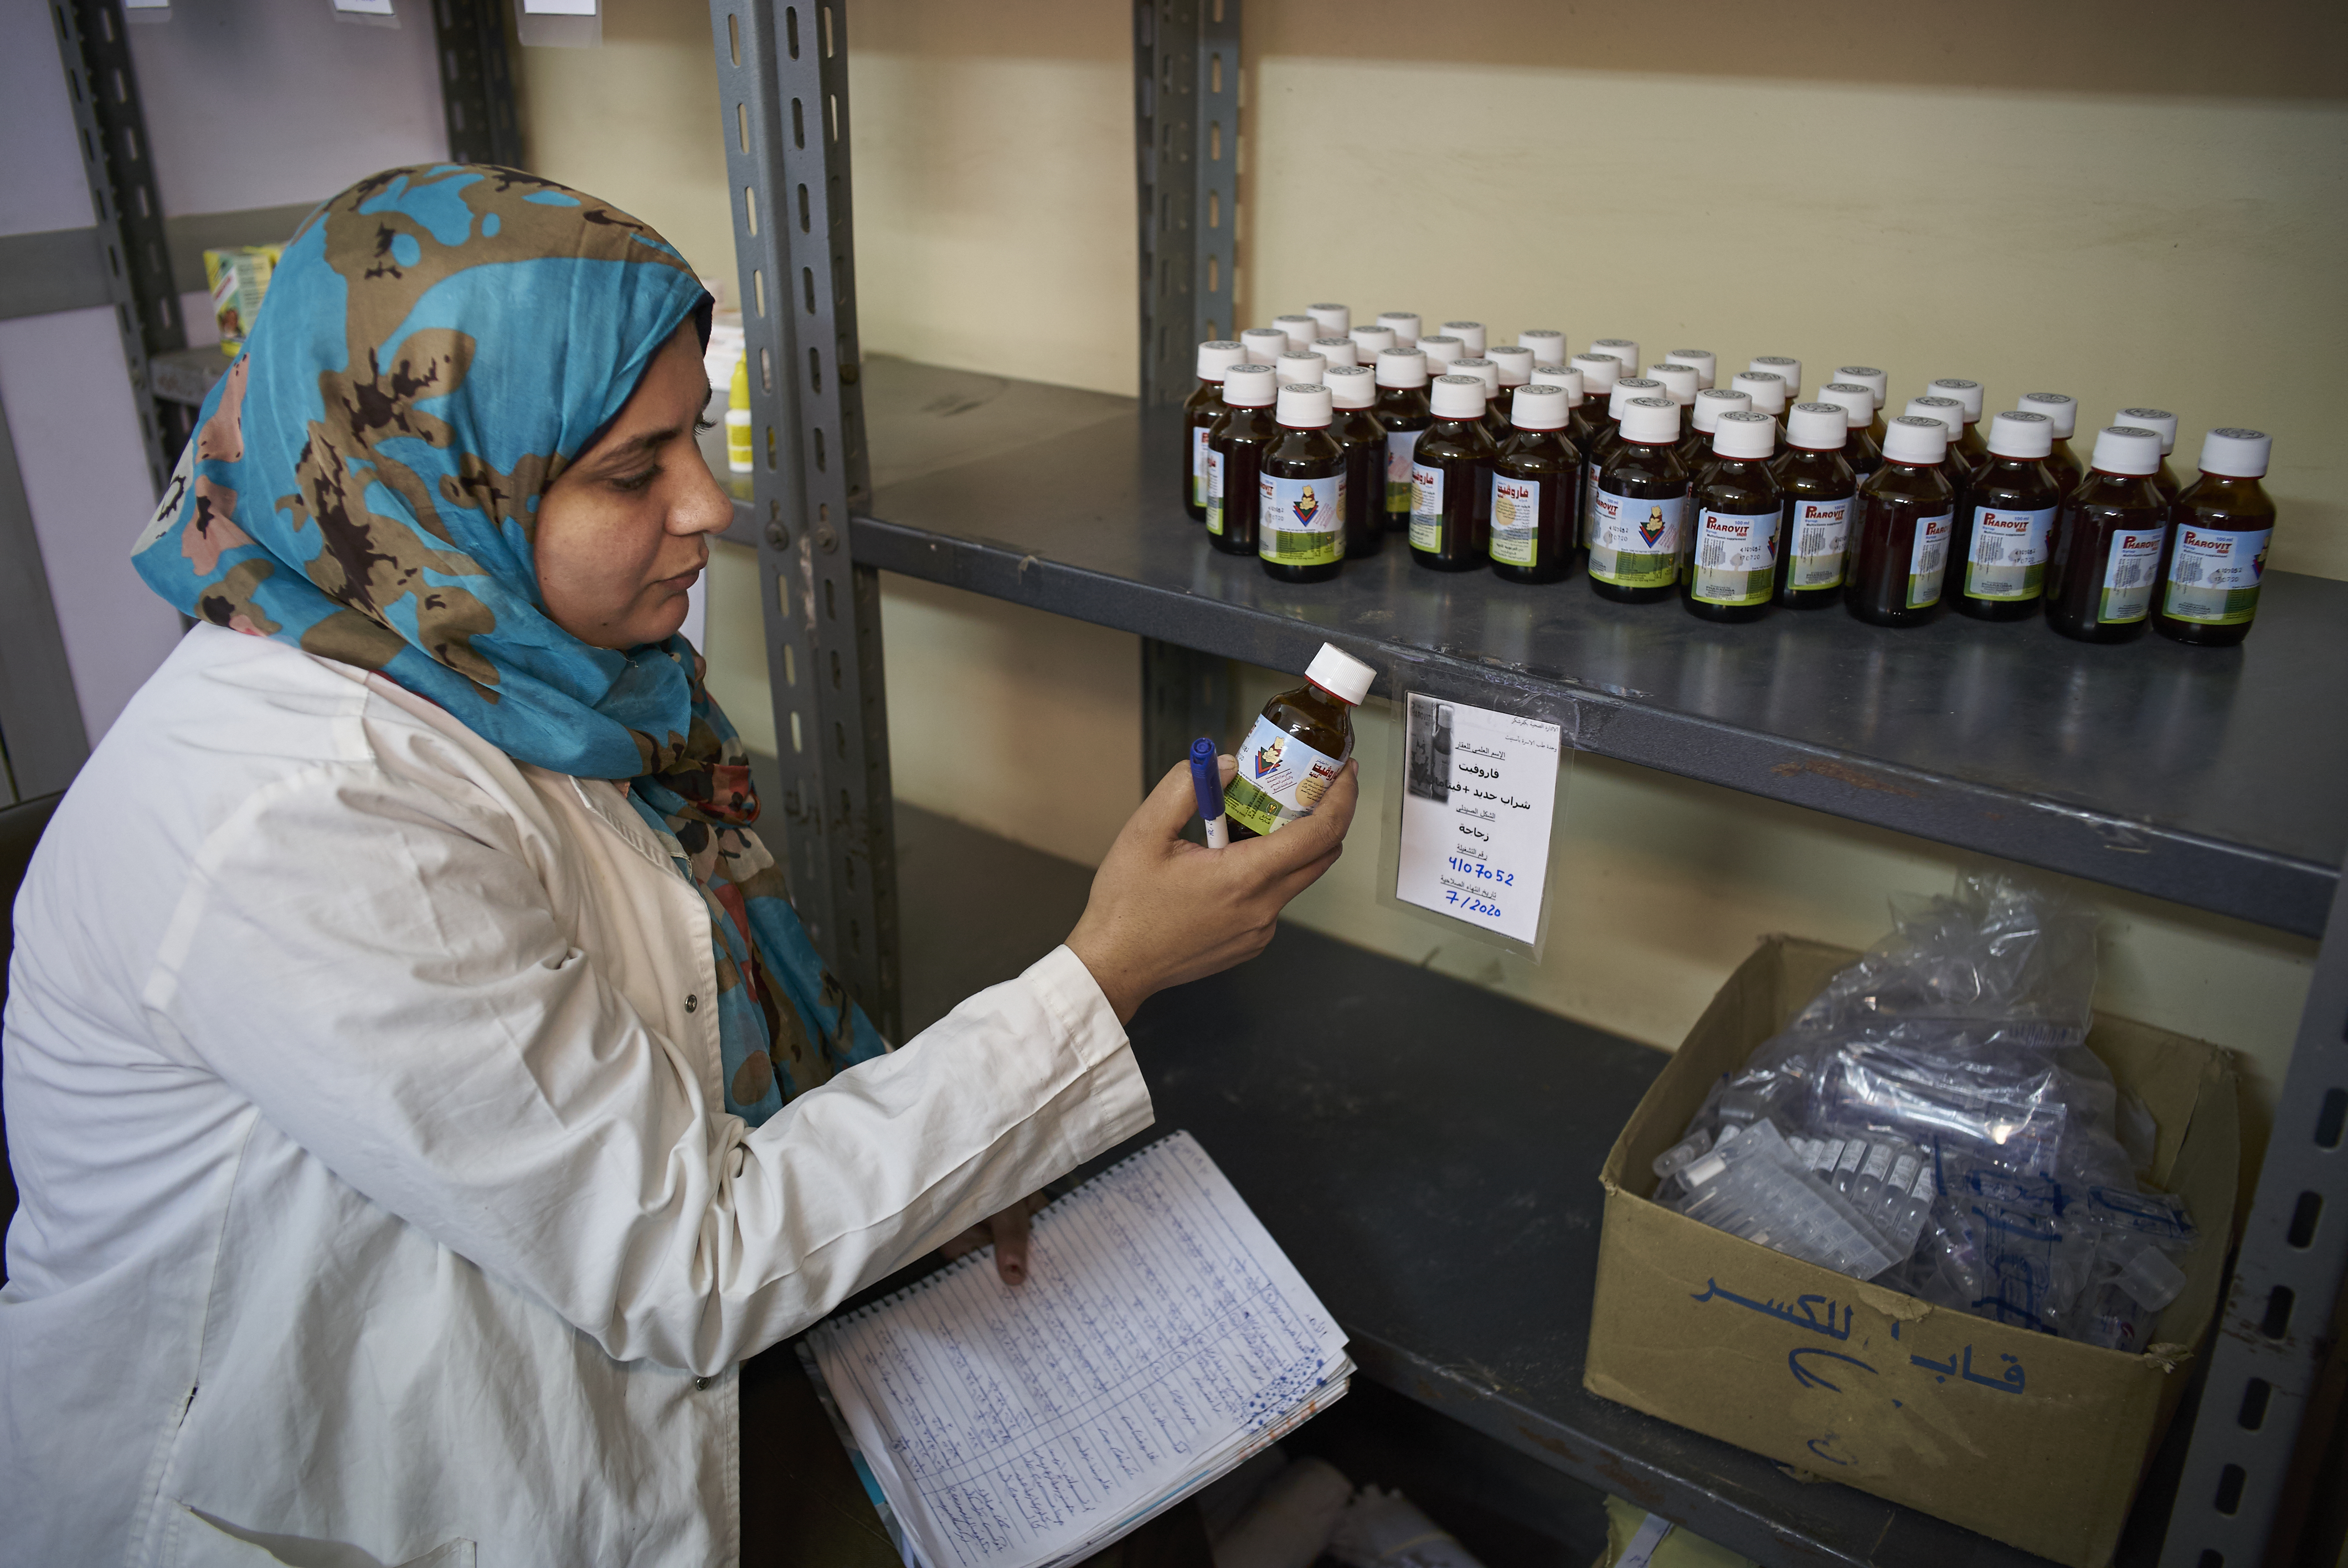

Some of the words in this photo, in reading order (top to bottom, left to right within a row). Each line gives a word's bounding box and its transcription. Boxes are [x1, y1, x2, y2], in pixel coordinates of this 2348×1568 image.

[1805, 506, 1845, 518] PHAROVIT
[1706, 516, 1749, 533] PHAROVIT
[1983, 513, 2029, 528] PHAROVIT
[2184, 531, 2232, 549] PHAROVIT
[1456, 741, 1471, 750] للعقار
[1459, 763, 1500, 778] فاروفيت
[1474, 789, 1497, 800] حديد
[1501, 796, 1531, 809] شراب
[1456, 804, 1478, 814] الصيدلى
[1480, 809, 1496, 819] الشكل
[1459, 823, 1489, 842] زجاجة
[1456, 843, 1476, 854] التشغيلة
[1478, 851, 1488, 860] رقم
[1449, 856, 1514, 886] 4107052
[1440, 875, 1465, 888] الصلاحية
[1466, 884, 1480, 893] انتهاء
[1482, 889, 1496, 899] تاريخ
[1690, 1277, 1854, 1342] للكسر
